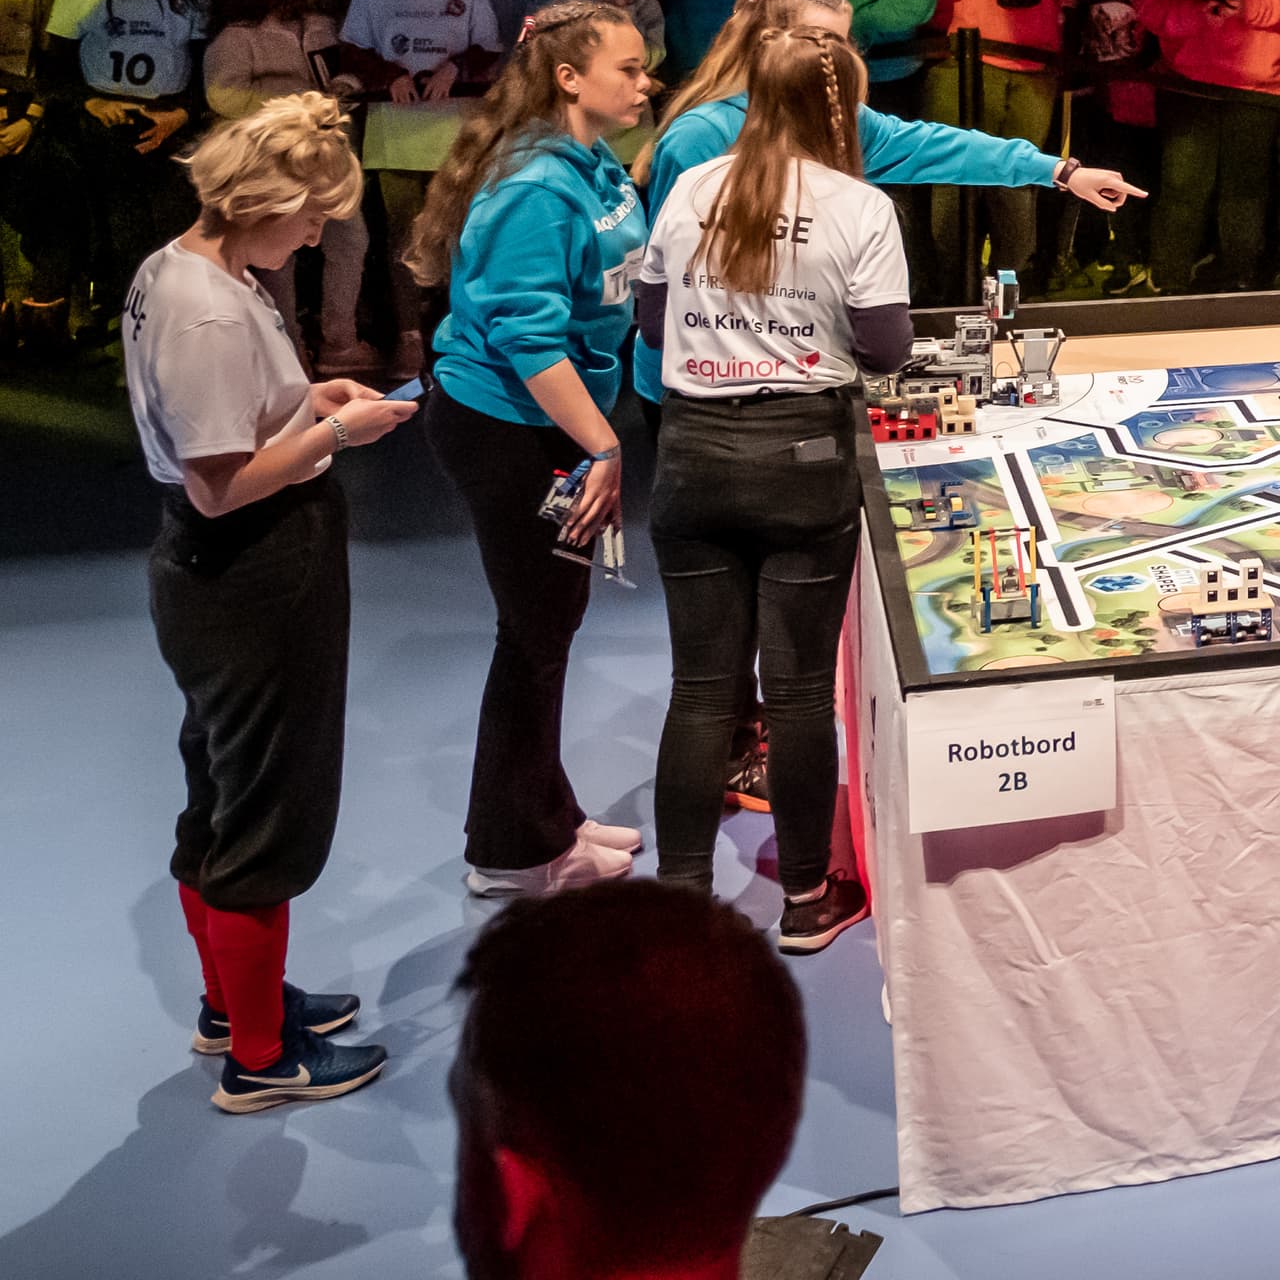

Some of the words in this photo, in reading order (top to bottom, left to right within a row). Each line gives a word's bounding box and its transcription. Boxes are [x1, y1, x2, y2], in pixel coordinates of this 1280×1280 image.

[108, 50, 156, 86] 10
[684, 312, 711, 329] Ole
[768, 320, 815, 338] Fond
[686, 356, 787, 383] equinor
[948, 731, 1077, 763] Robotbord
[998, 771, 1029, 793] 2B
